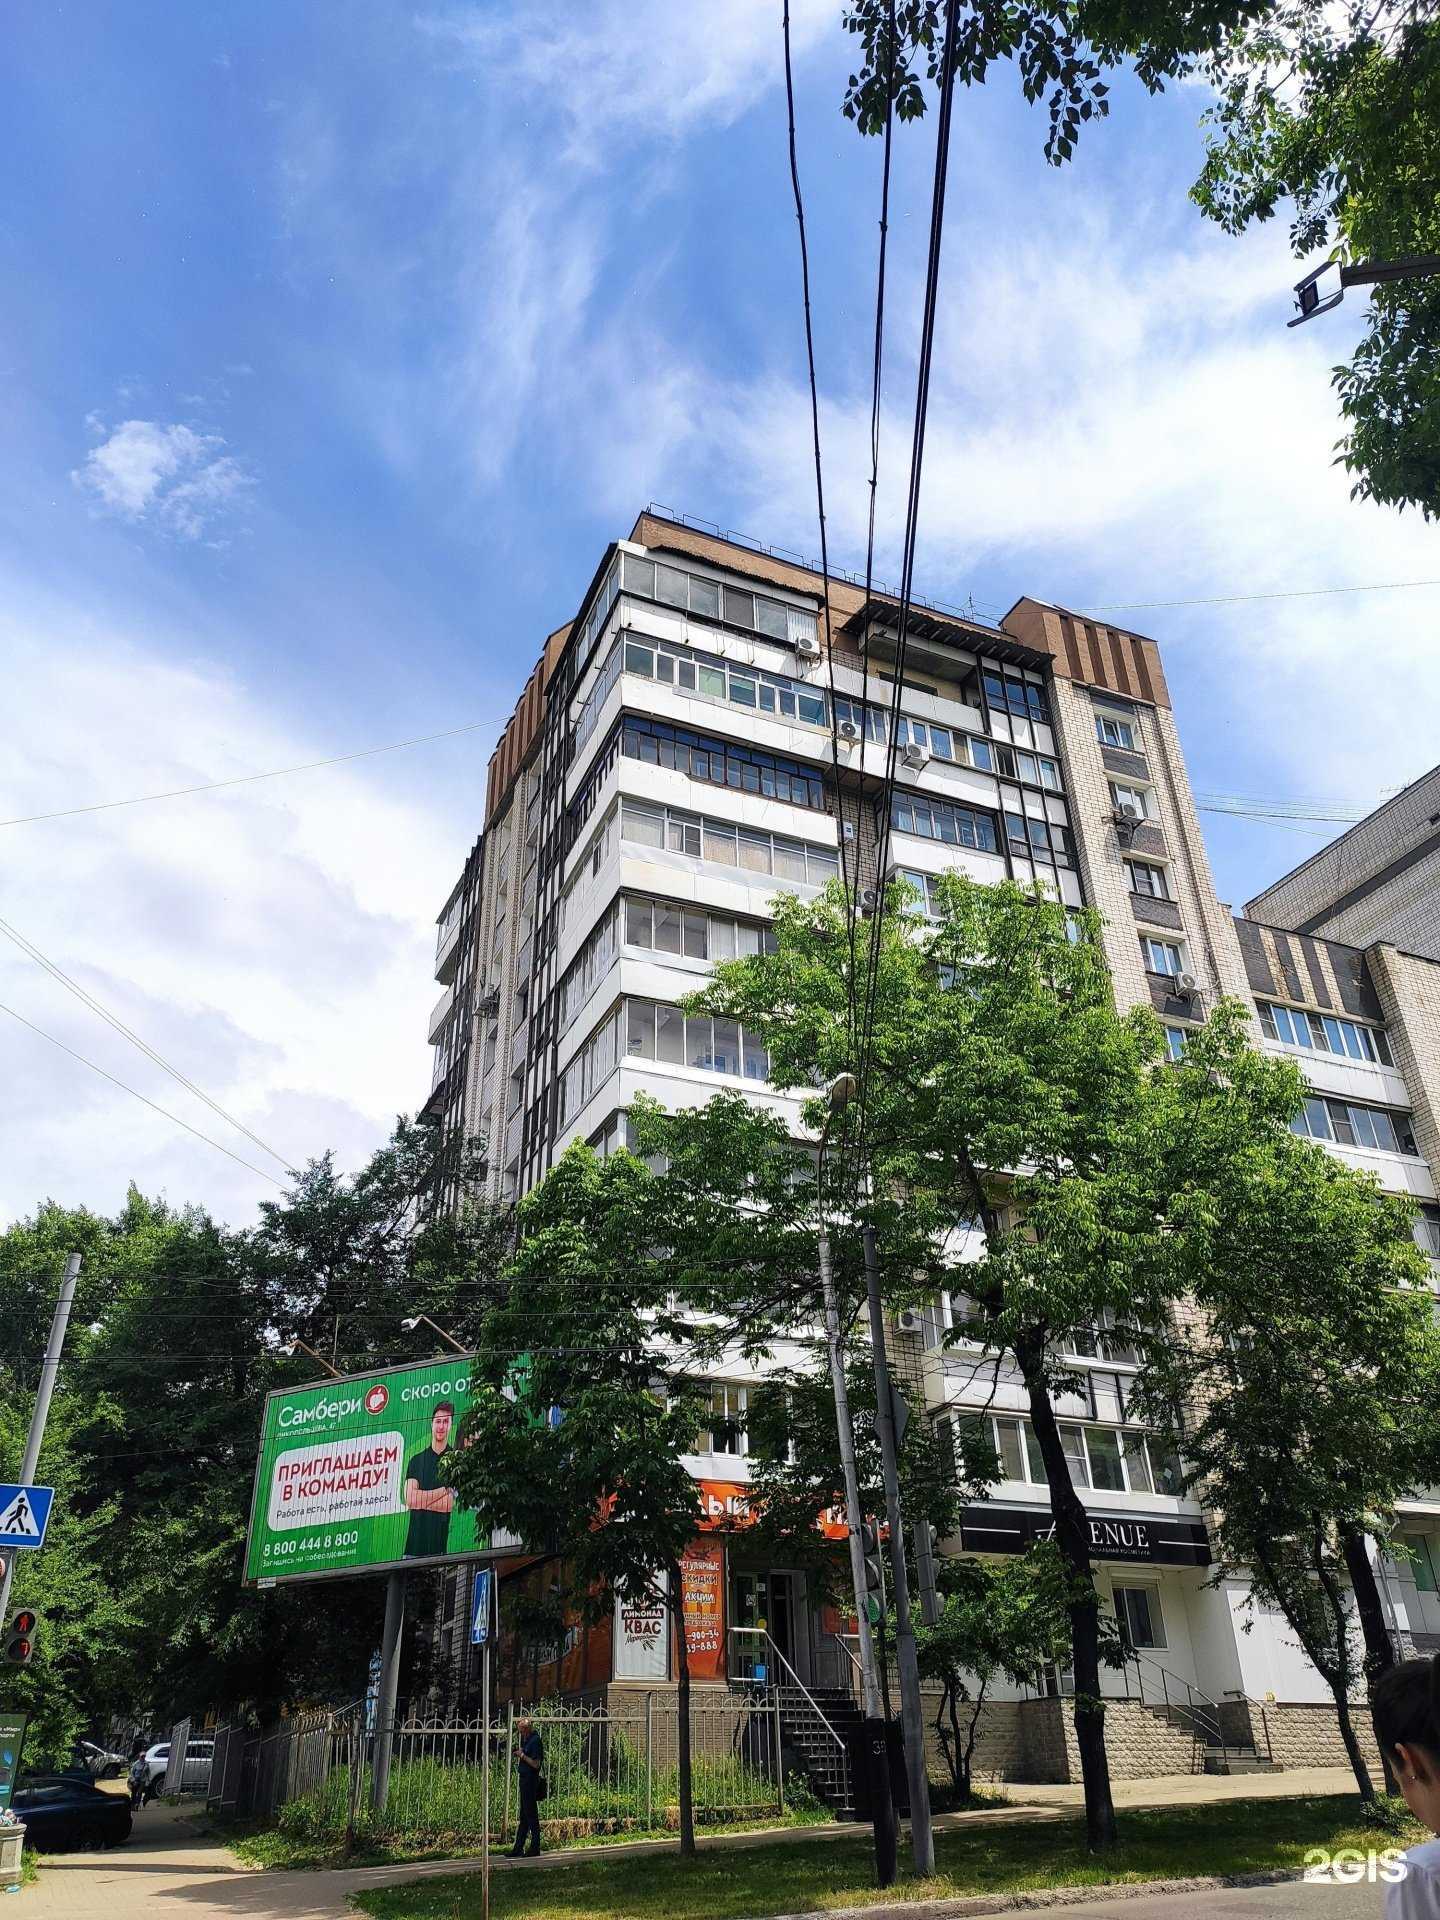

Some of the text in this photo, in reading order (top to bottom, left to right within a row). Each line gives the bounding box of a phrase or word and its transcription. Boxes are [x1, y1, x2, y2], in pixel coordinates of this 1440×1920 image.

[401, 1381, 451, 1402] СКОРО
[278, 1398, 362, 1428] Самбери
[278, 1446, 398, 1482] ПРИГЛАШАЕМ
[283, 1467, 389, 1502] В КОМАНДУ!
[276, 1493, 392, 1519] Работа есть, работай здесь!
[263, 1530, 359, 1557] 8 800 444 8 800
[678, 1560, 720, 1571] РЕГУЛЯРНЫЕ
[681, 1573, 718, 1586] СКИДКИ
[684, 1591, 716, 1604] АКЦИИ
[623, 1610, 662, 1619] ЛИМОНАД
[624, 1619, 662, 1635] КВАС
